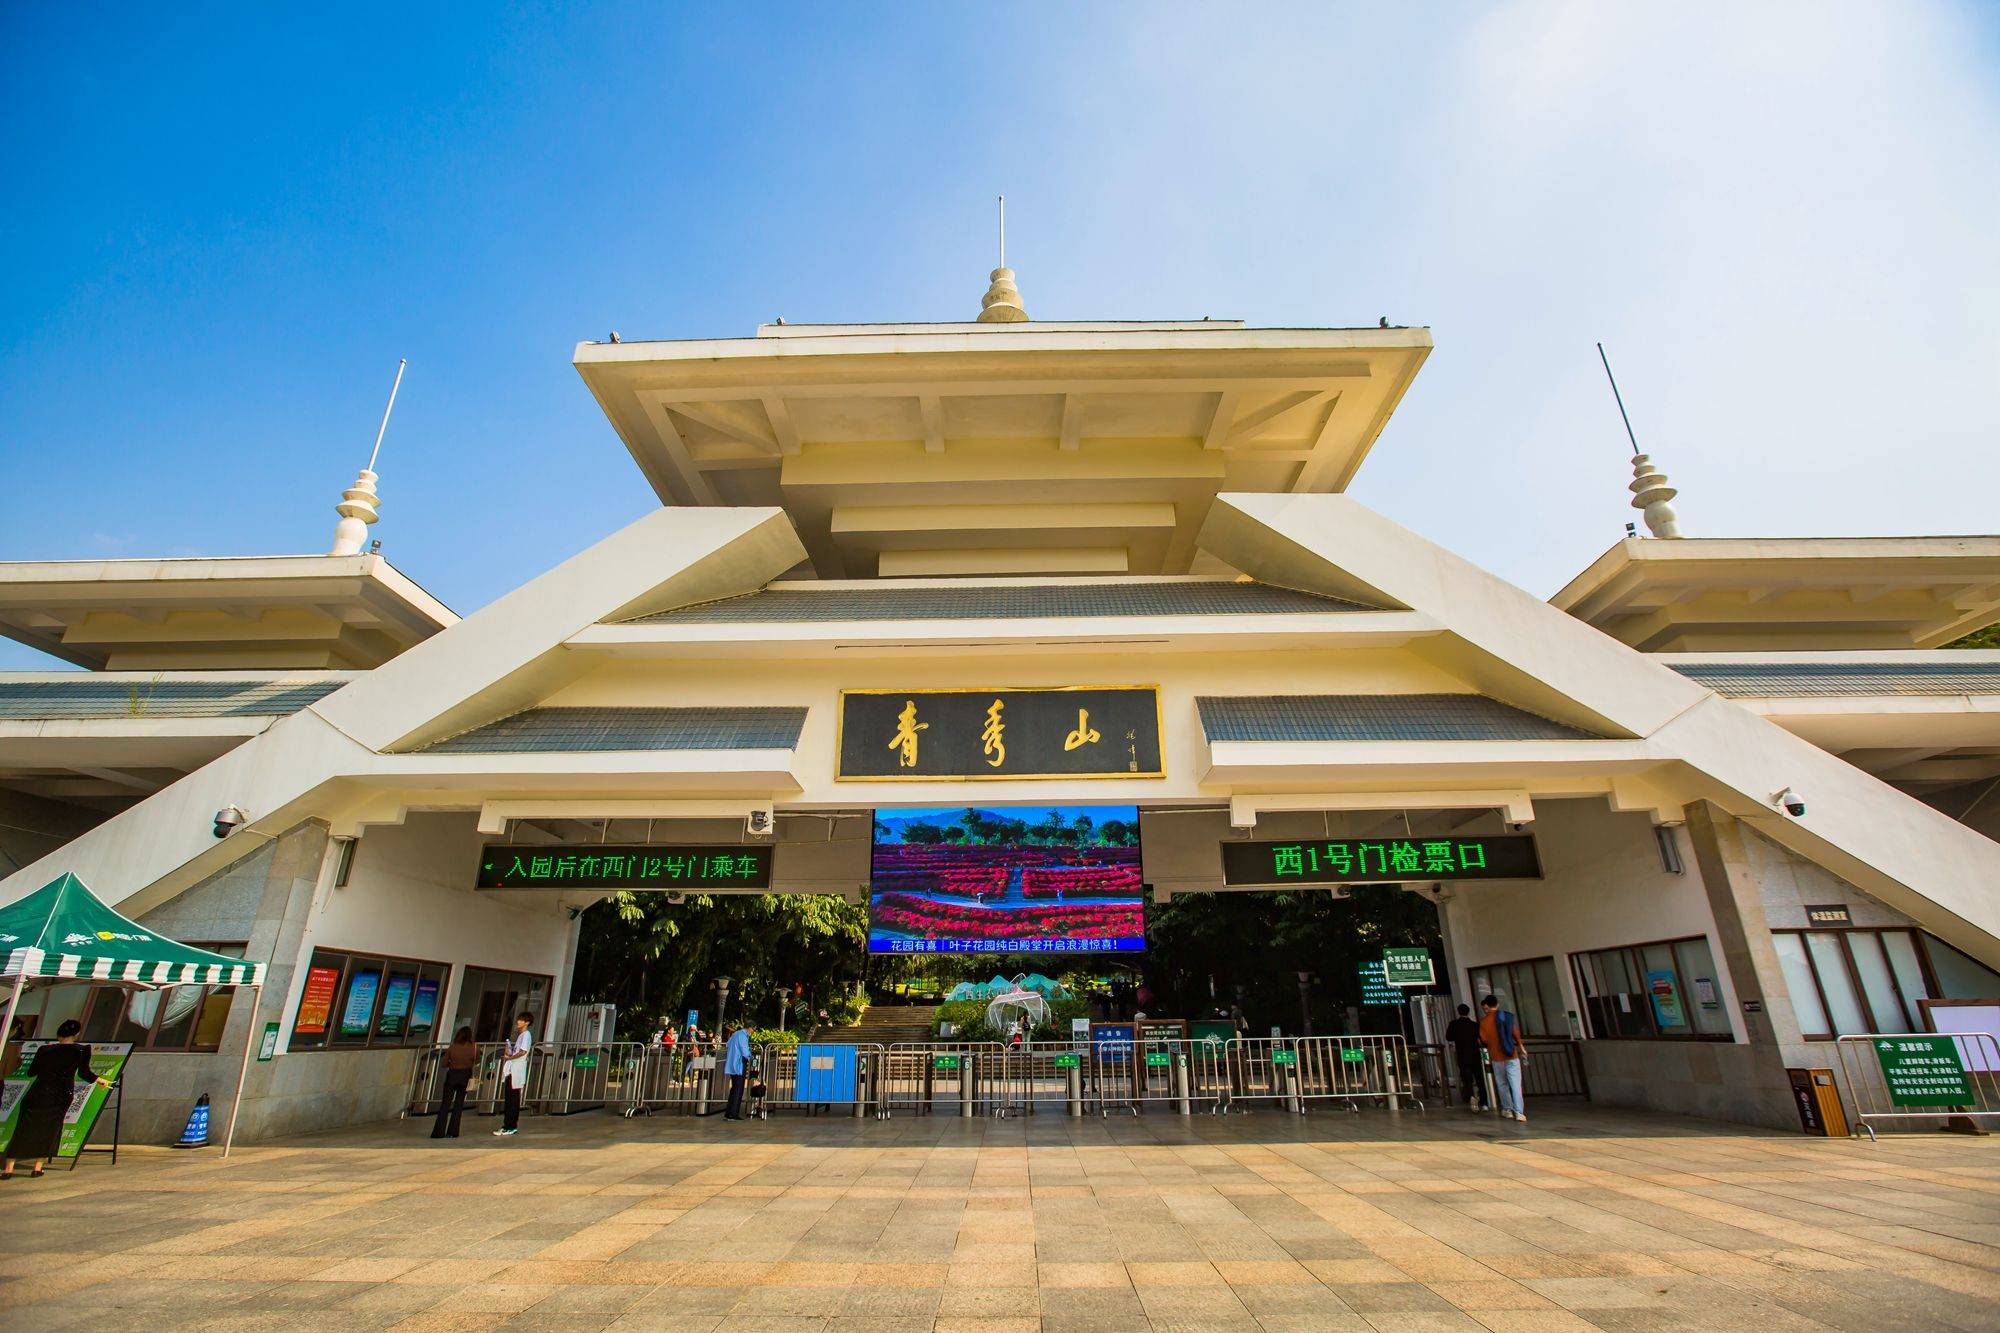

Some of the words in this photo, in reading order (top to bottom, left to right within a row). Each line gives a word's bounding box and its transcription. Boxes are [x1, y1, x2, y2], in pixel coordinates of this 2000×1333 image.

[888, 699, 1101, 767] 青秀山
[1272, 841, 1487, 875] 西1号门检票口
[504, 855, 759, 879] 入园后在西门2号门乘车
[891, 940, 937, 951] 花园有喜
[1395, 962, 1422, 970] 专用通道
[1898, 1042, 1934, 1052] 温馨提示
